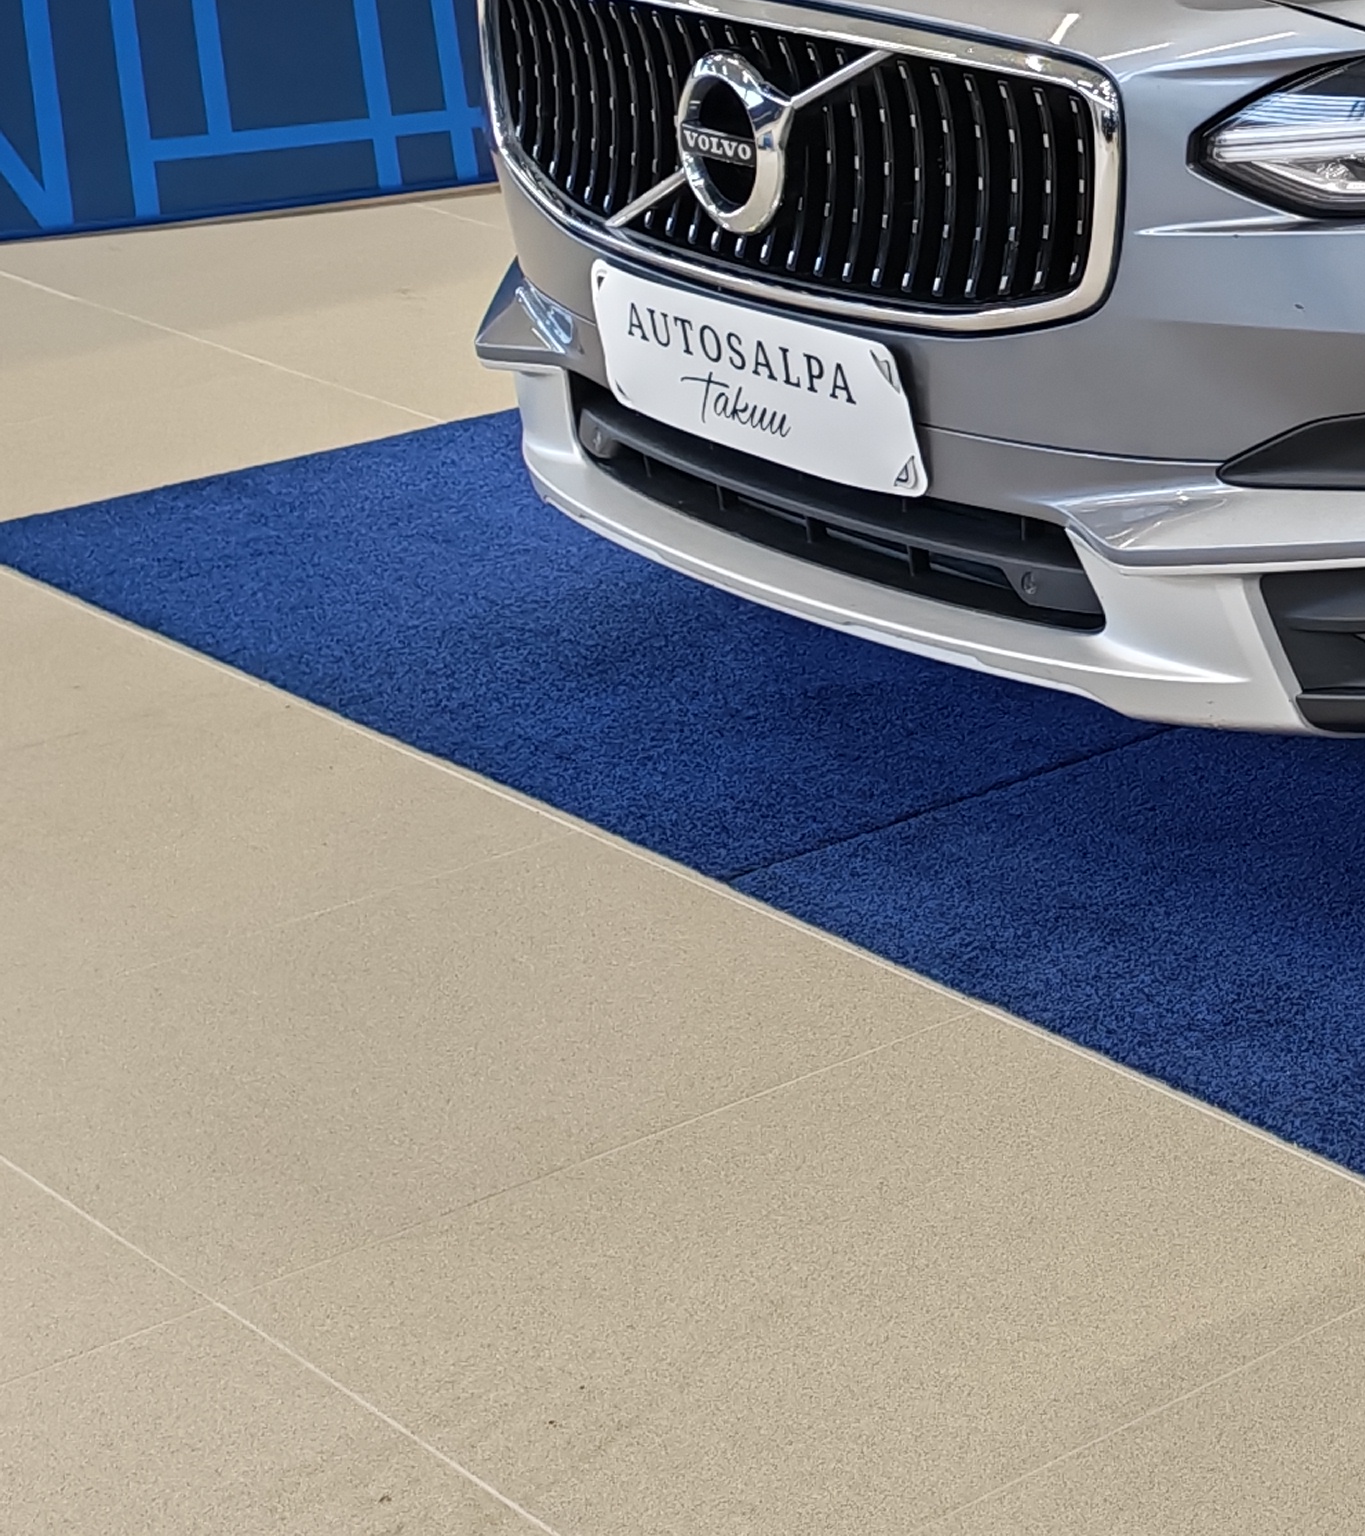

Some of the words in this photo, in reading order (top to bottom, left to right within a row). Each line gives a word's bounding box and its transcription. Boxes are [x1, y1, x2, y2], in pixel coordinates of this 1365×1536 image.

[683, 129, 752, 160] VOLVO
[627, 302, 857, 406] AUTOSALPA
[680, 371, 792, 438] Takuu
